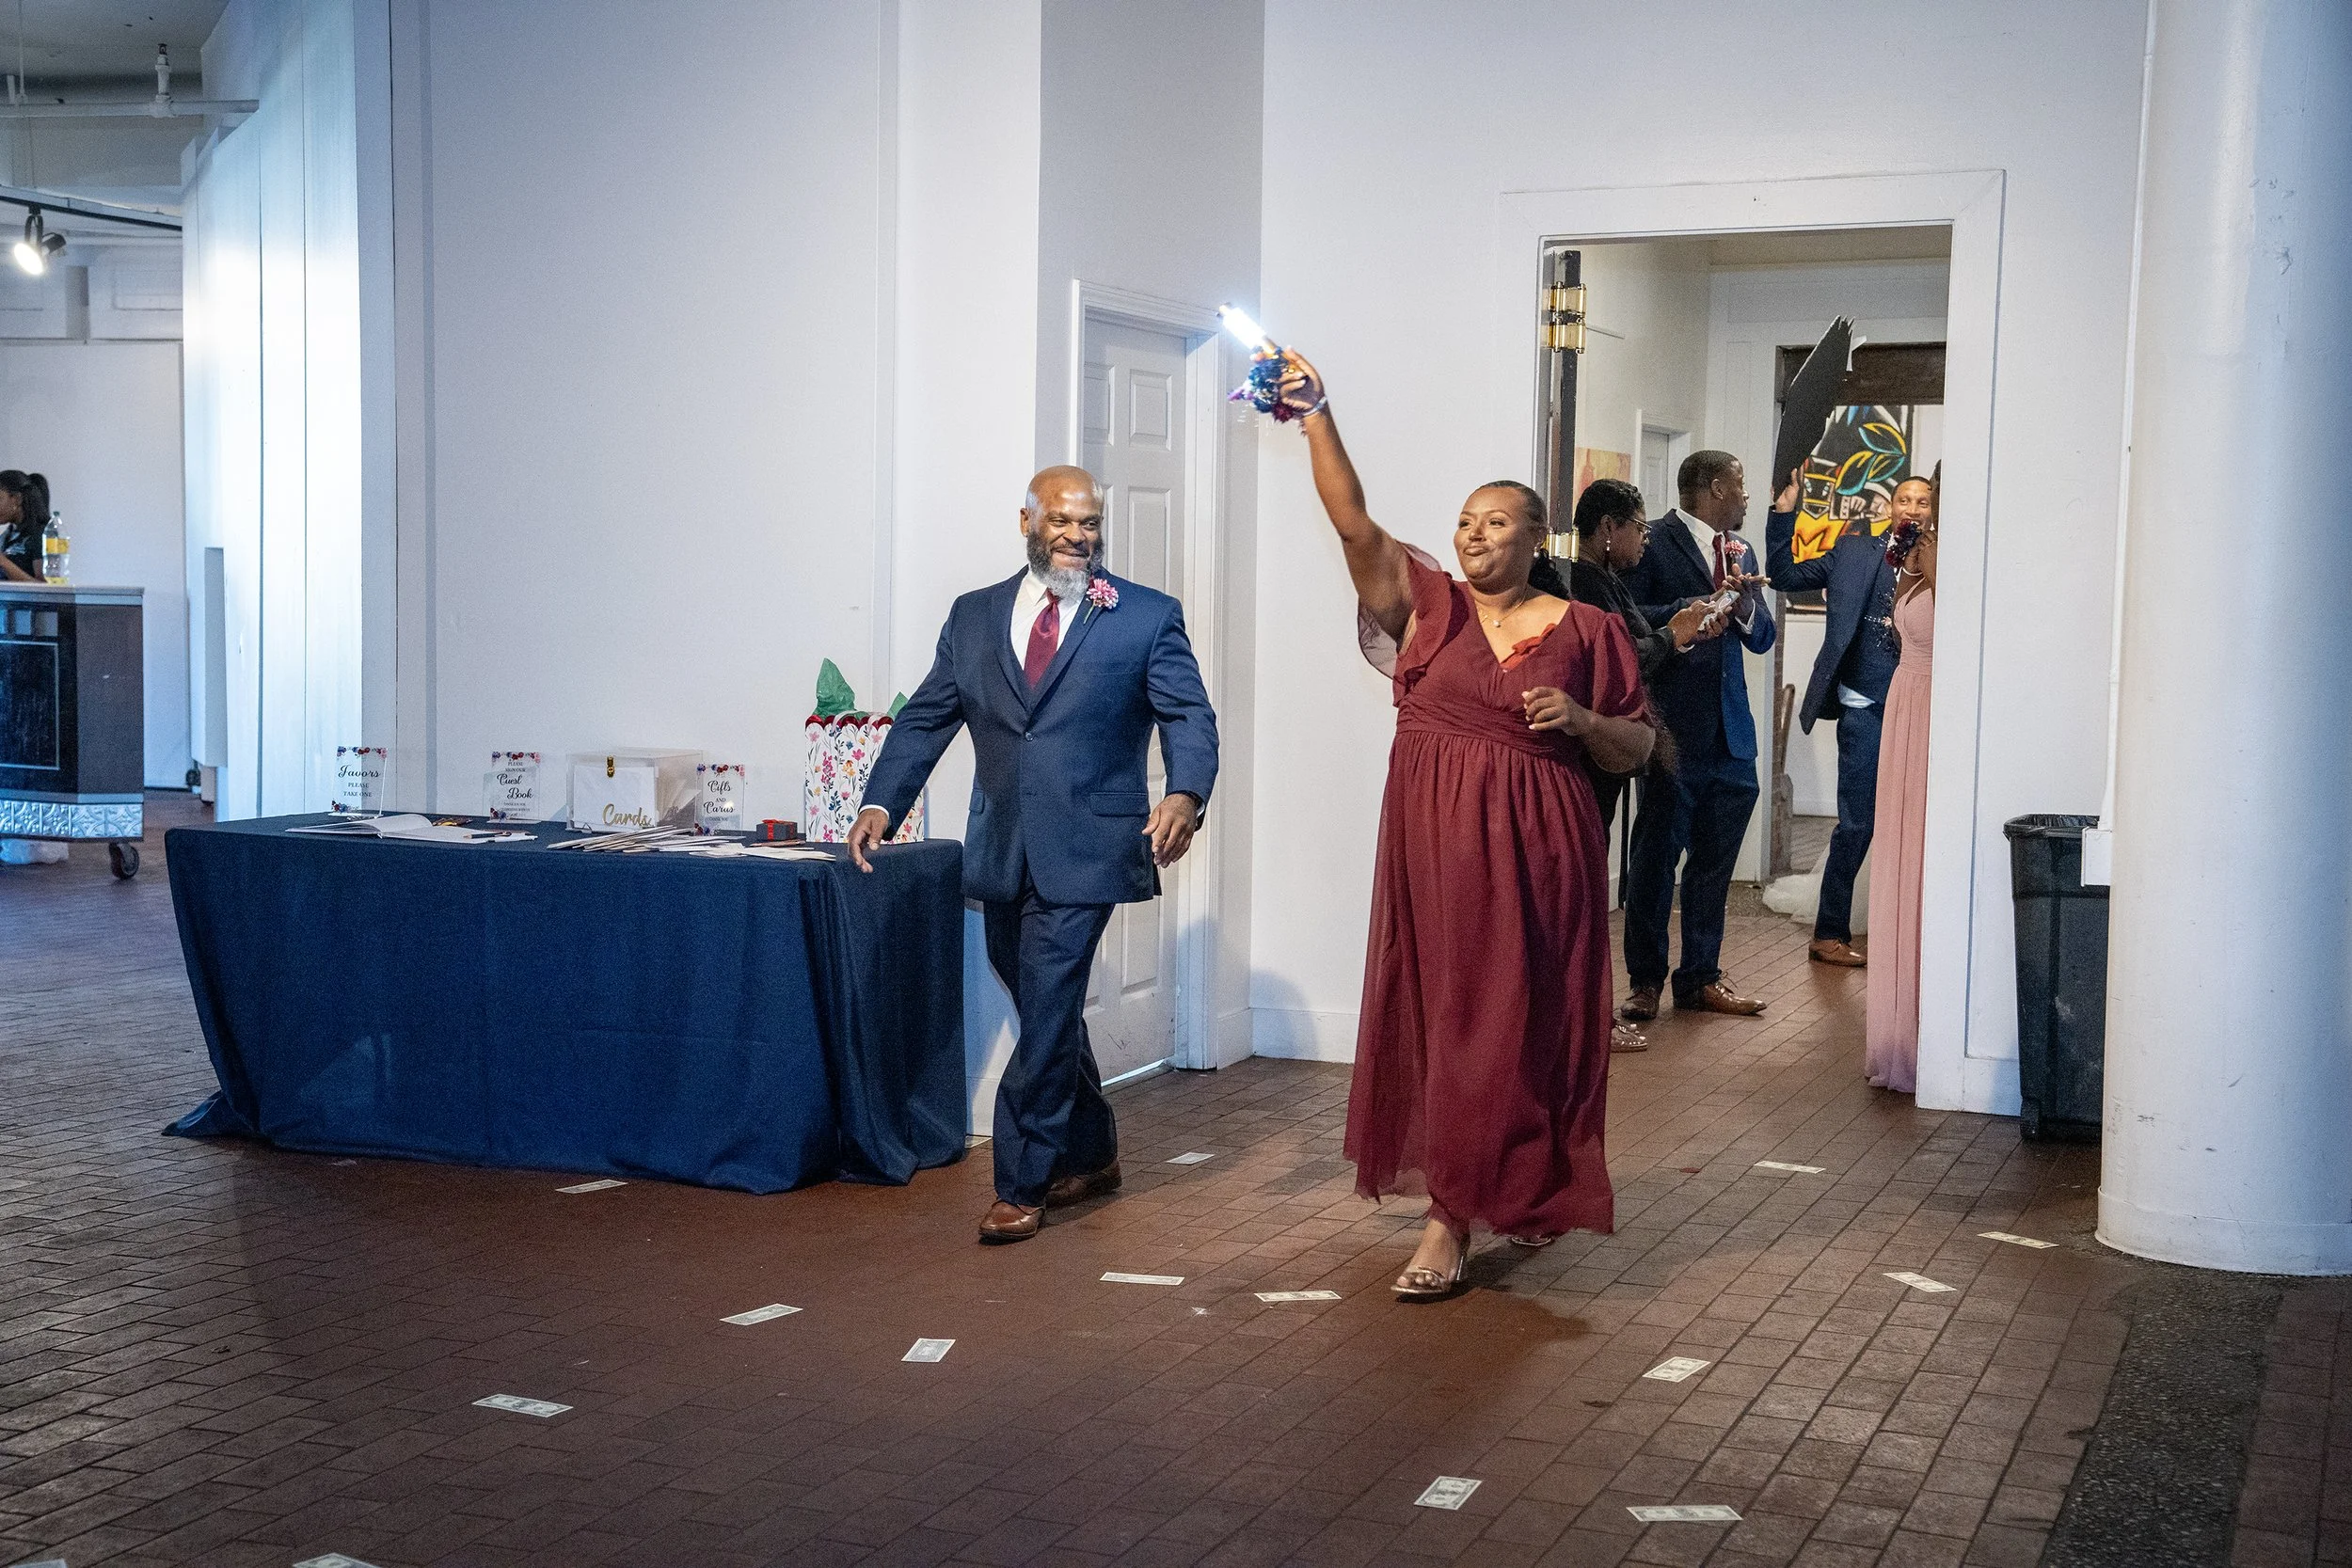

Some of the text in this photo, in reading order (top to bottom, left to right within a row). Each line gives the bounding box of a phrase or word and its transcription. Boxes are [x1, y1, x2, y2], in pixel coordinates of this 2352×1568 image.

[339, 765, 381, 778] Favors
[497, 773, 522, 785] Guest
[507, 787, 533, 799] Book
[707, 780, 731, 795] Gifts
[603, 803, 653, 826] Cards
